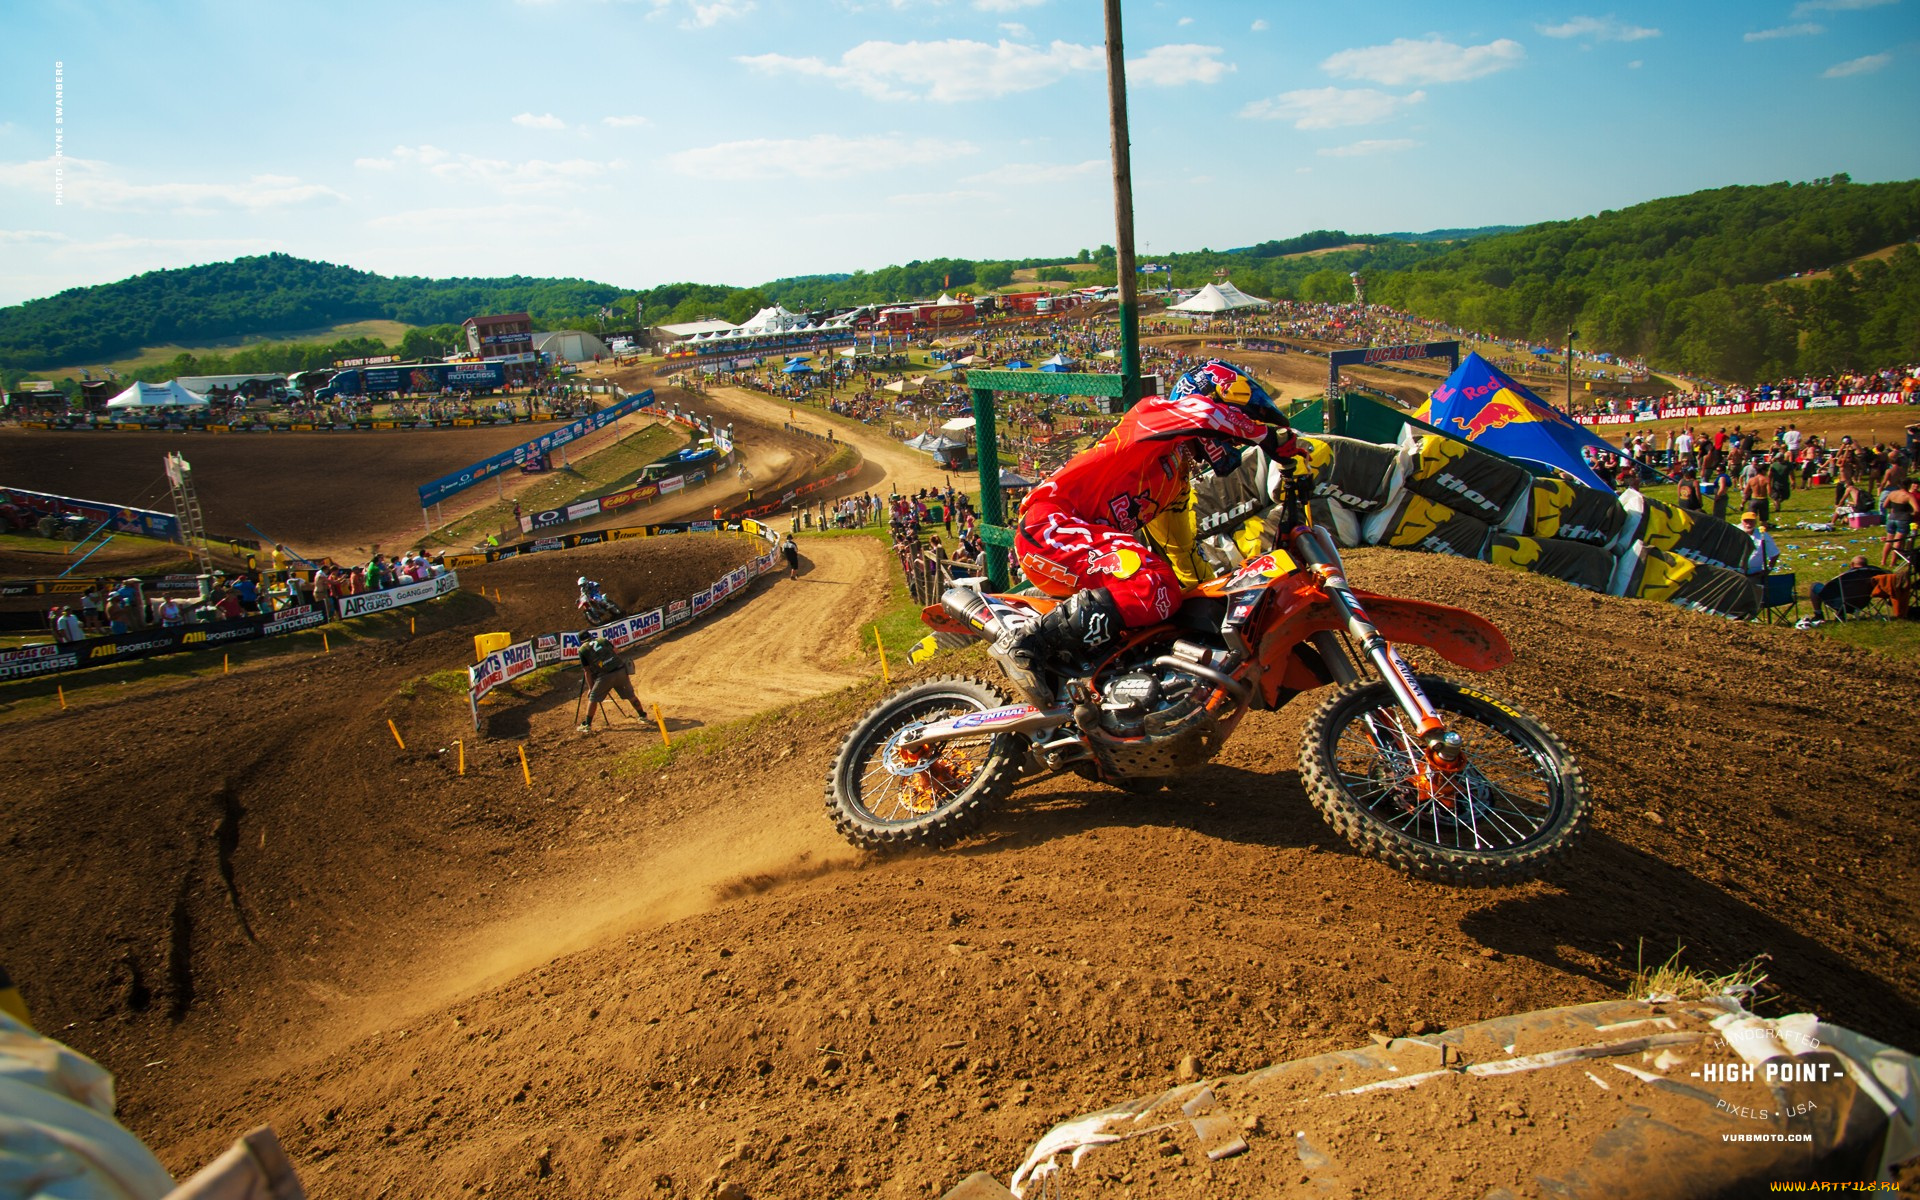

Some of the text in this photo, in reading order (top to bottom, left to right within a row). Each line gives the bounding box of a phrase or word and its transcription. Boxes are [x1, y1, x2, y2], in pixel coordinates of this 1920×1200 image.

[343, 355, 392, 367] EVENT T-SHIRTS
[1364, 344, 1428, 363] LUCAS OIL
[448, 371, 496, 380] MOTOCROSS
[1462, 375, 1501, 401] Red
[1753, 399, 1800, 412] LUCAS OIL
[1843, 392, 1899, 406] LUCAS OIL
[1661, 408, 1686, 419] LUCAS
[1687, 407, 1699, 417] OIL
[1705, 402, 1747, 416] LUCAS OIL
[1598, 414, 1632, 425] LUCAS OIL
[1313, 481, 1378, 510] thor
[1436, 472, 1500, 512] thor
[1200, 497, 1258, 532] thor
[534, 518, 565, 530] OAKLEY
[658, 527, 679, 535] thor
[619, 531, 641, 540] thor
[1022, 552, 1079, 587] KTM
[364, 592, 391, 601] NATIONAL
[396, 587, 434, 600] GoANG.com
[275, 604, 312, 620] LUCAS OIL
[344, 597, 368, 616] AIR
[366, 598, 393, 612] GUARD
[263, 612, 325, 634] MOTOCROSS
[630, 611, 660, 632] PARTS
[602, 623, 628, 641] PARTS
[631, 622, 661, 640] UNLIMITED
[589, 640, 602, 652] 2
[2, 646, 57, 662] LUCAS OIL
[0, 655, 78, 677] OTOCROSS
[1115, 678, 1153, 689] KTM
[1457, 687, 1522, 718] DUNLOP
